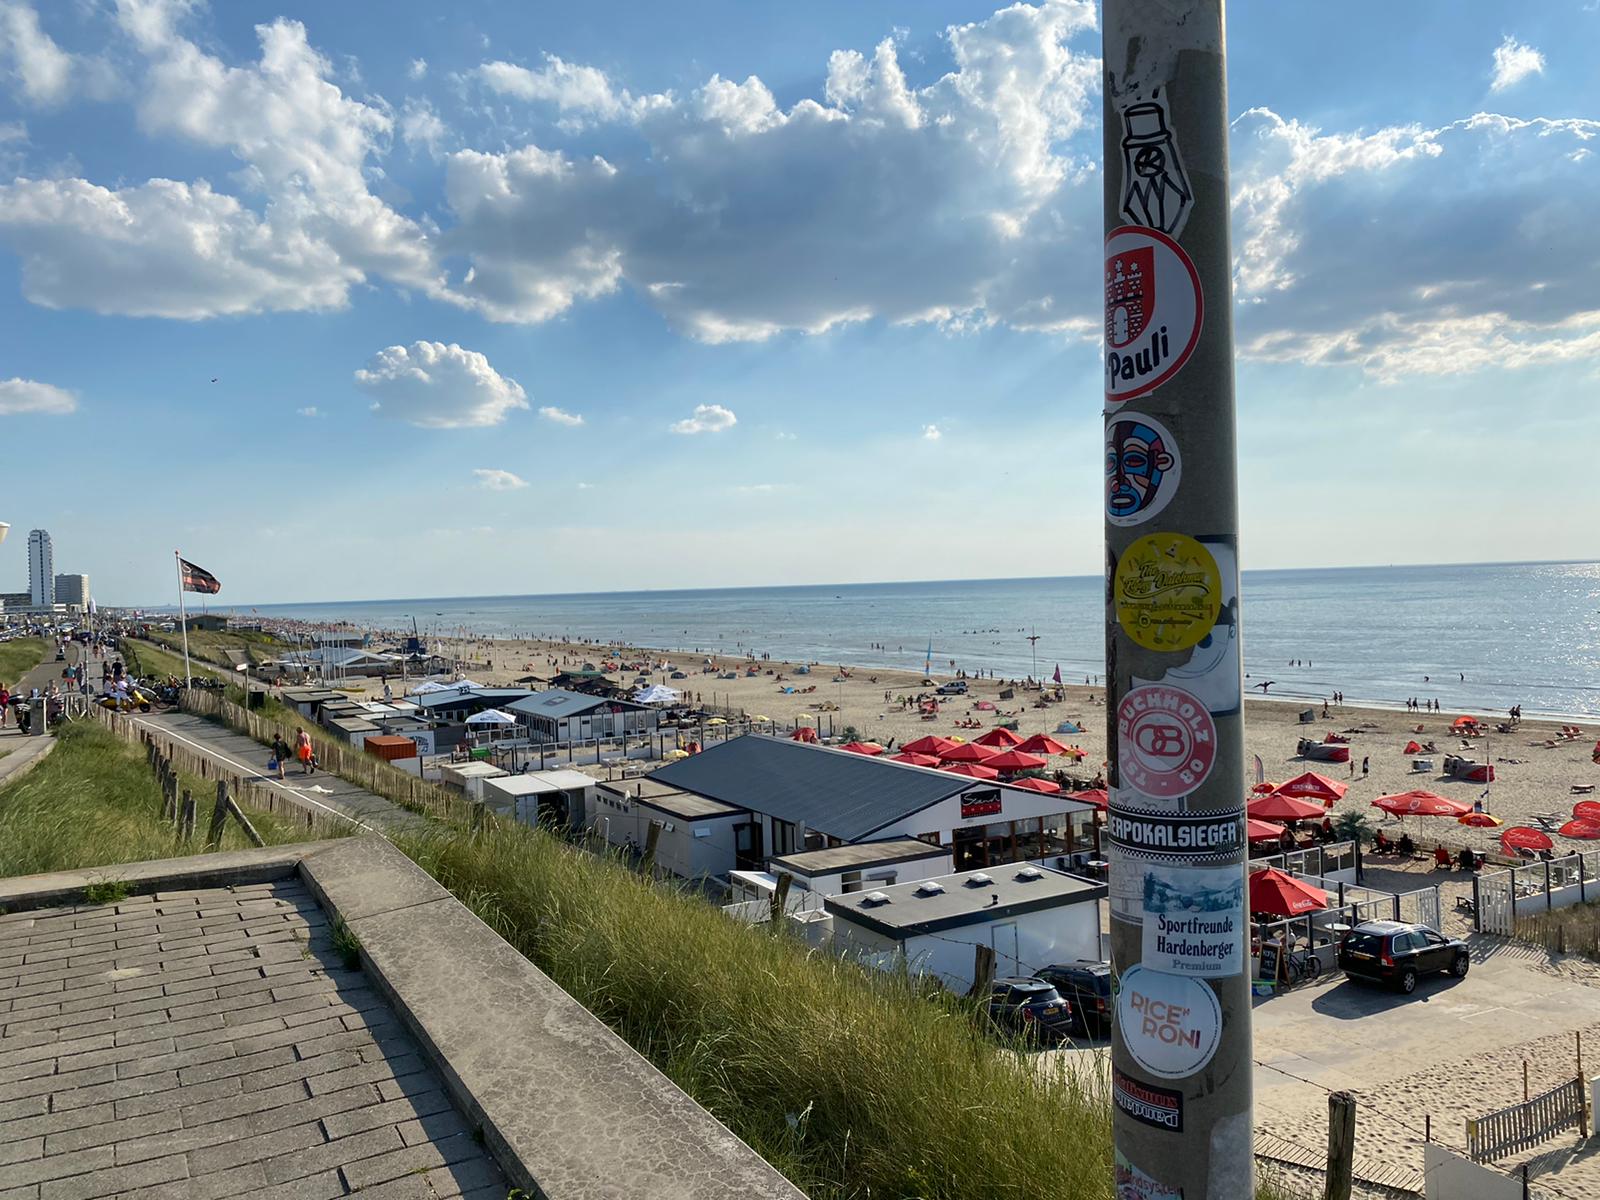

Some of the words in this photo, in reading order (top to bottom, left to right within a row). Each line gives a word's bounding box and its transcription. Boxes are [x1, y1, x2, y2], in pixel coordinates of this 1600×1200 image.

[1107, 326, 1169, 389] Pauli
[1119, 692, 1210, 743] BUCHHOLZ
[1109, 815, 1237, 847] ERPOKALSIEGER
[1158, 913, 1233, 935] Sportfreunde
[1157, 935, 1234, 960] Hardenberger
[1172, 958, 1222, 971] Premium
[1142, 1017, 1200, 1050] RONI
